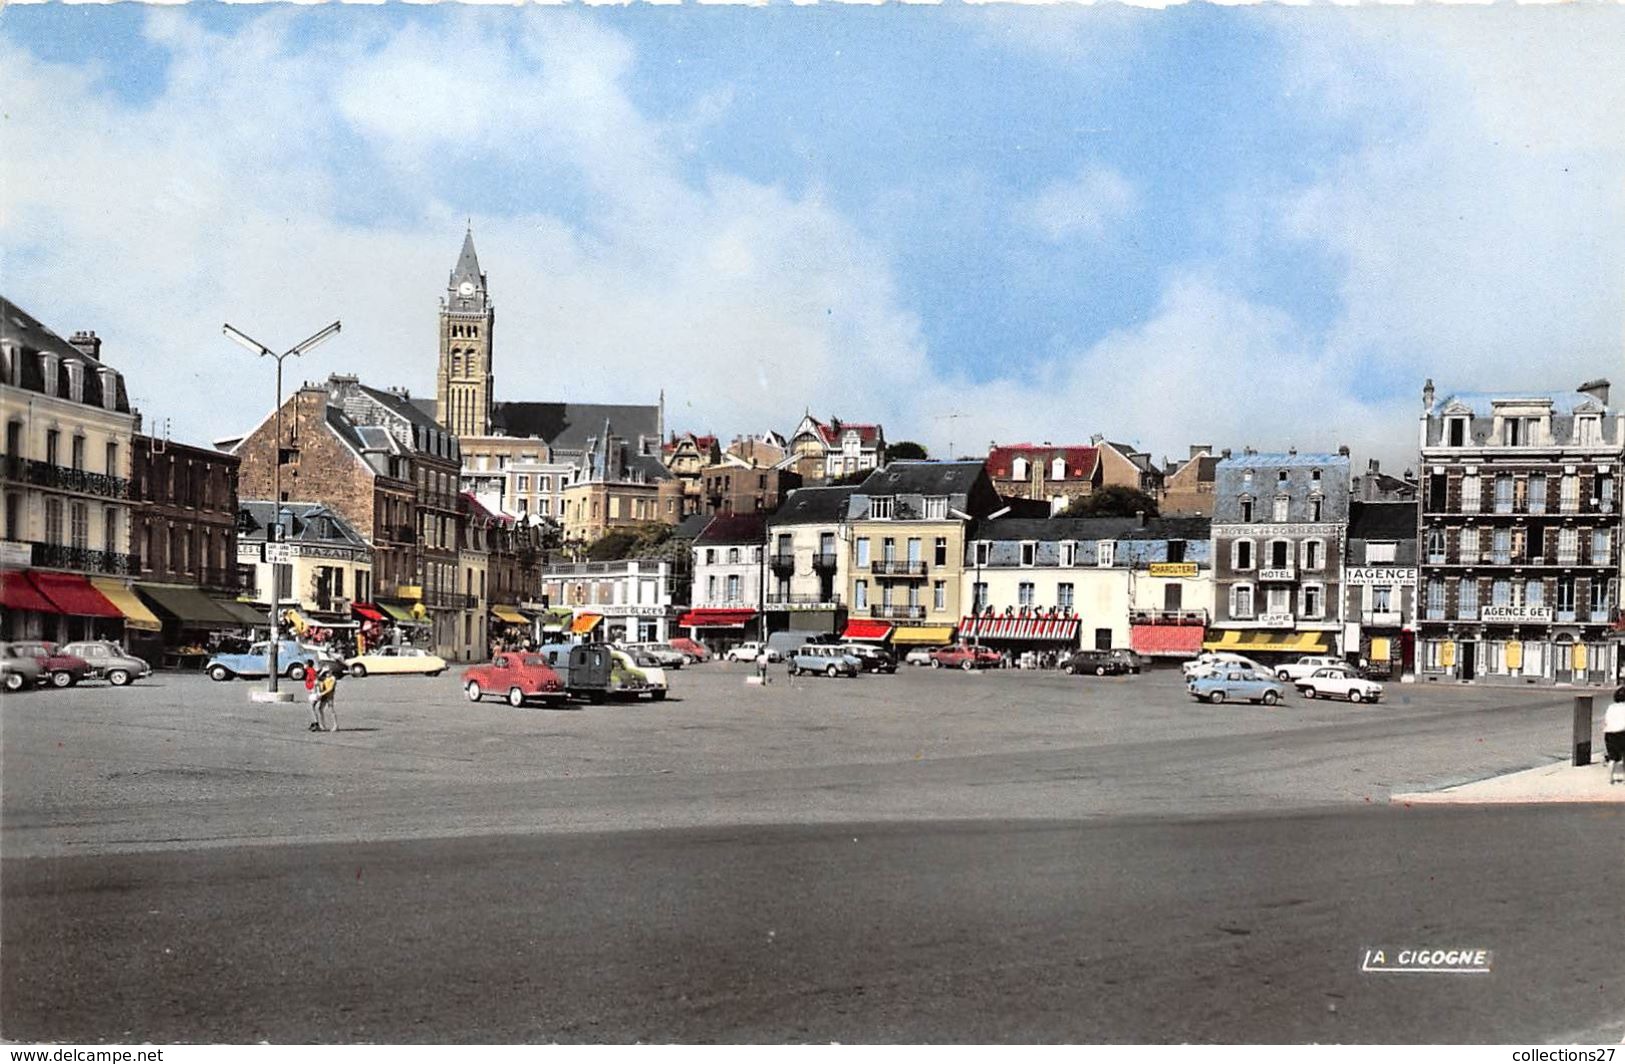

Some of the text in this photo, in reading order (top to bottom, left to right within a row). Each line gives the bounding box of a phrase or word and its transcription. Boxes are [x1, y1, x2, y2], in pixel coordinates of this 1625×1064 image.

[303, 547, 350, 558] BAZAR
[1151, 565, 1197, 573] CHARCUTERIE
[1261, 571, 1292, 579] HOTEL
[1354, 569, 1415, 579] AGENCE
[630, 607, 664, 615] GLACES
[1484, 607, 1551, 616] AGENCE GET
